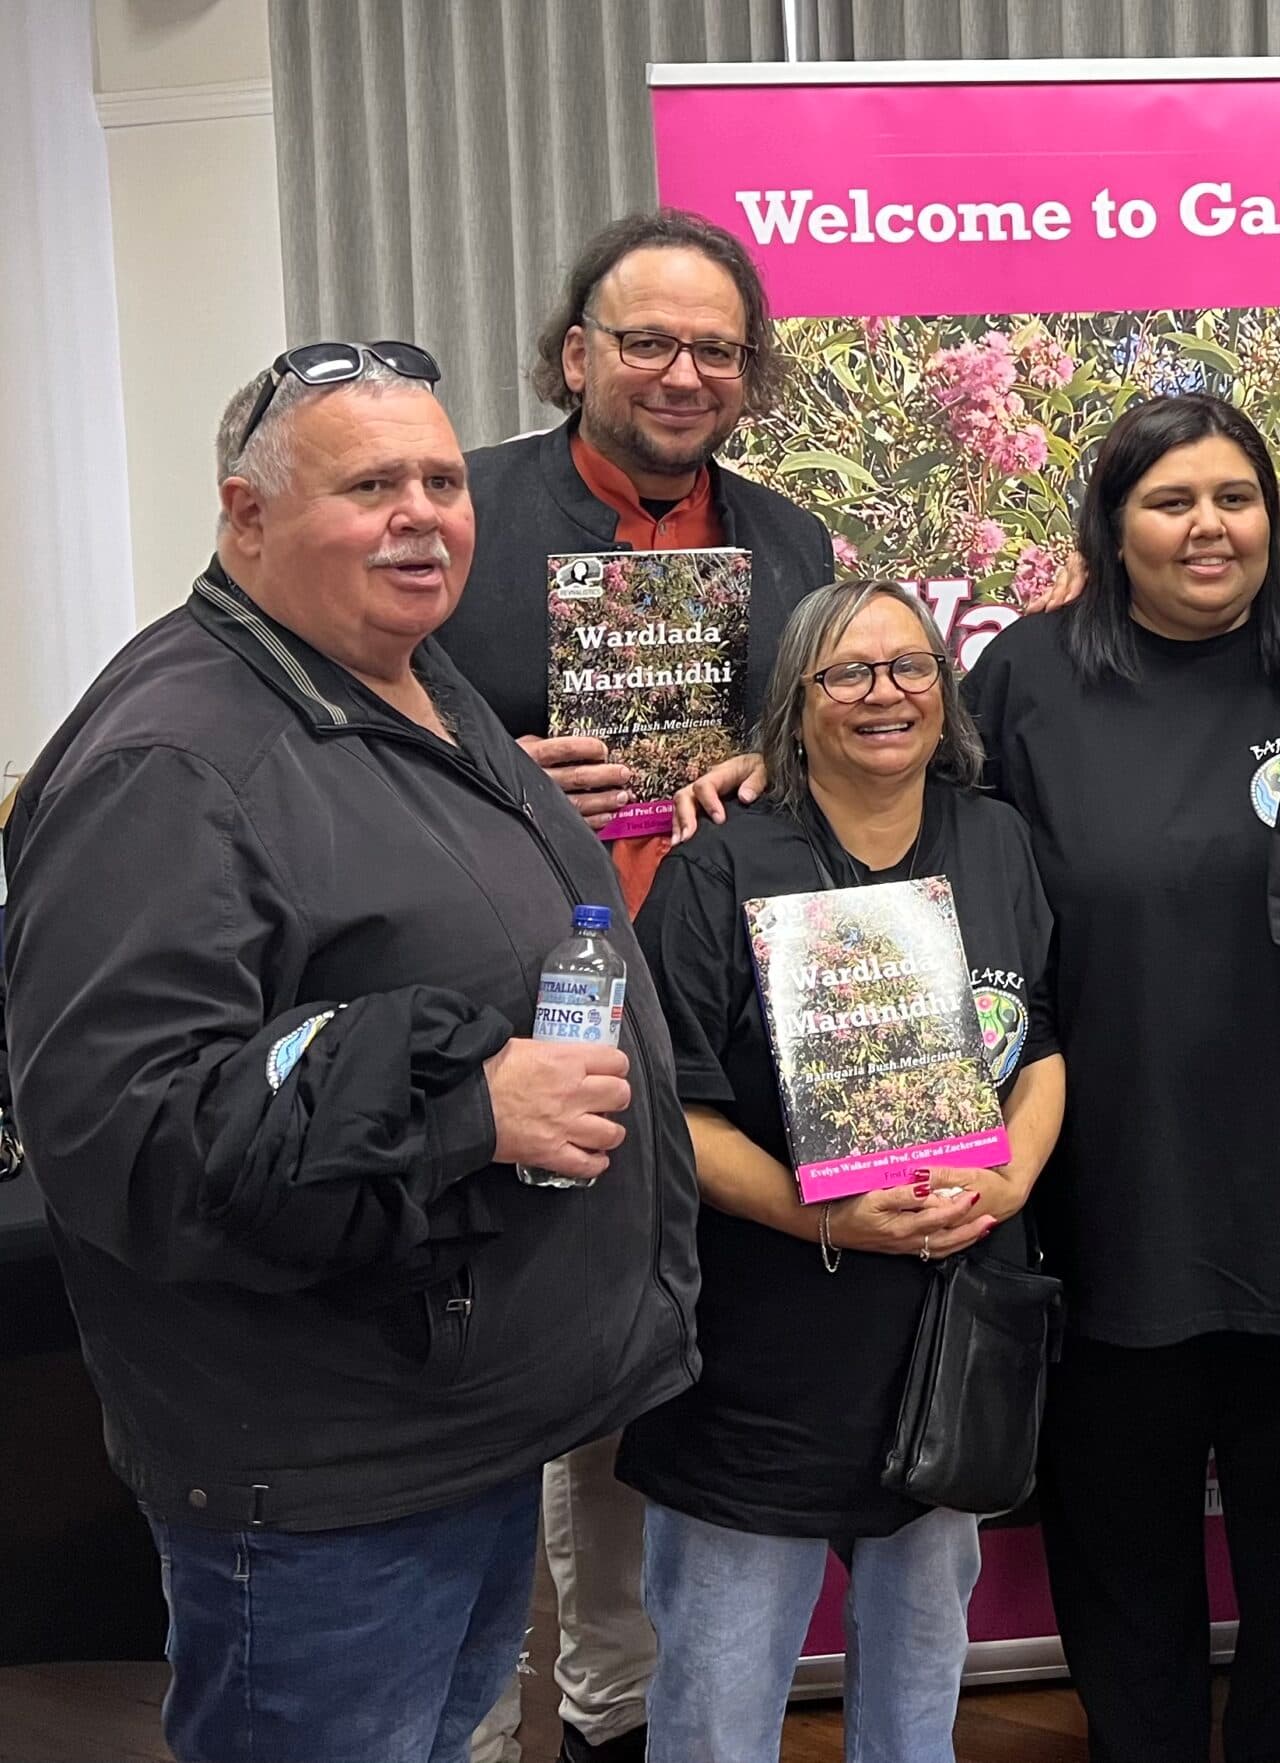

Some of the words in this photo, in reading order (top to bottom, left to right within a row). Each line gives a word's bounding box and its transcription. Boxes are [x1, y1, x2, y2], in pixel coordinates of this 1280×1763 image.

[736, 189, 1071, 245] Welcome
[1092, 189, 1157, 239] to
[575, 622, 721, 649] Wardlada
[562, 661, 732, 693] Mardinidhi
[632, 721, 661, 733] Bush
[664, 718, 722, 730] Medicines
[791, 956, 940, 990] Wardlada
[538, 1008, 583, 1024] PRING
[785, 992, 961, 1037] Mardinidhi
[805, 1066, 864, 1083] Barngarla
[868, 1059, 897, 1073] Bush
[901, 1050, 962, 1068] Medicines
[840, 1161, 871, 1171] Walker
[873, 1157, 889, 1167] and
